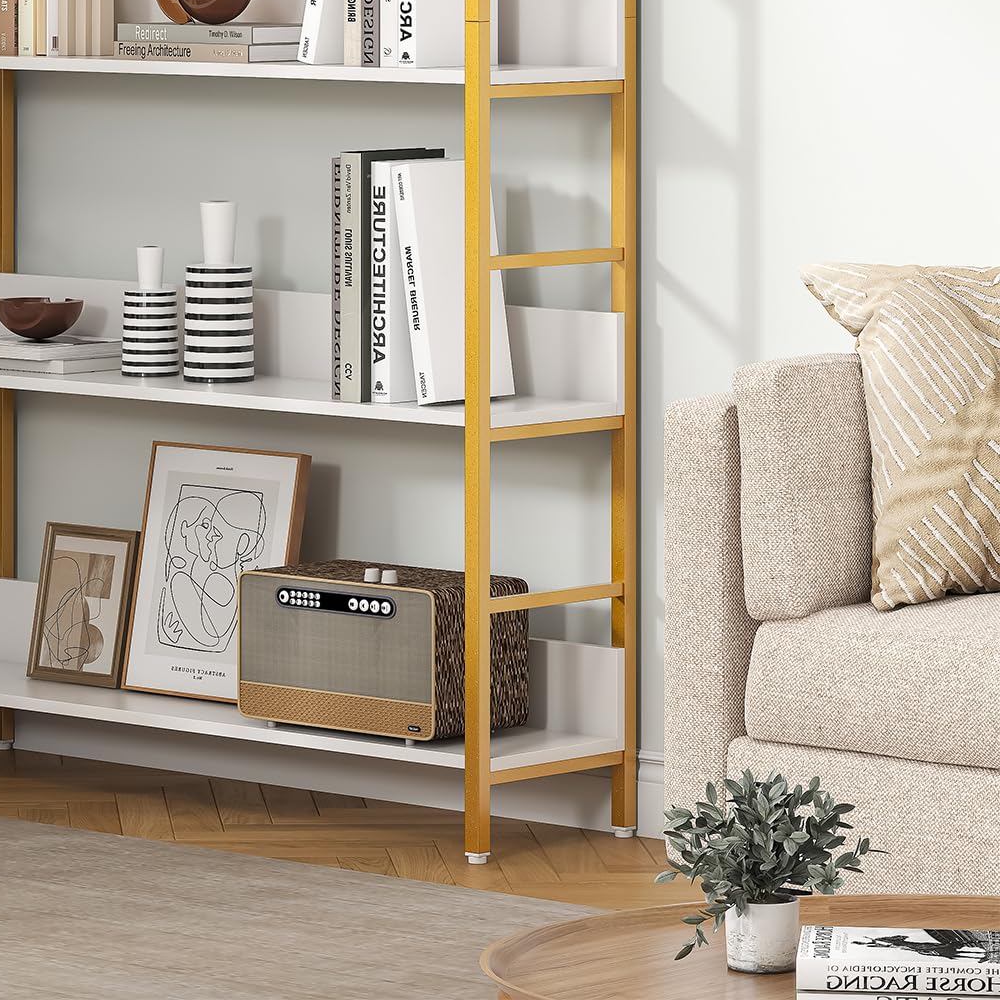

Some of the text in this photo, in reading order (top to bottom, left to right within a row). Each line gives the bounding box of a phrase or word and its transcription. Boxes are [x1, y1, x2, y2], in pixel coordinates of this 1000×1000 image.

[135, 25, 167, 40] Redirect
[118, 43, 191, 60] Freeing Architecture
